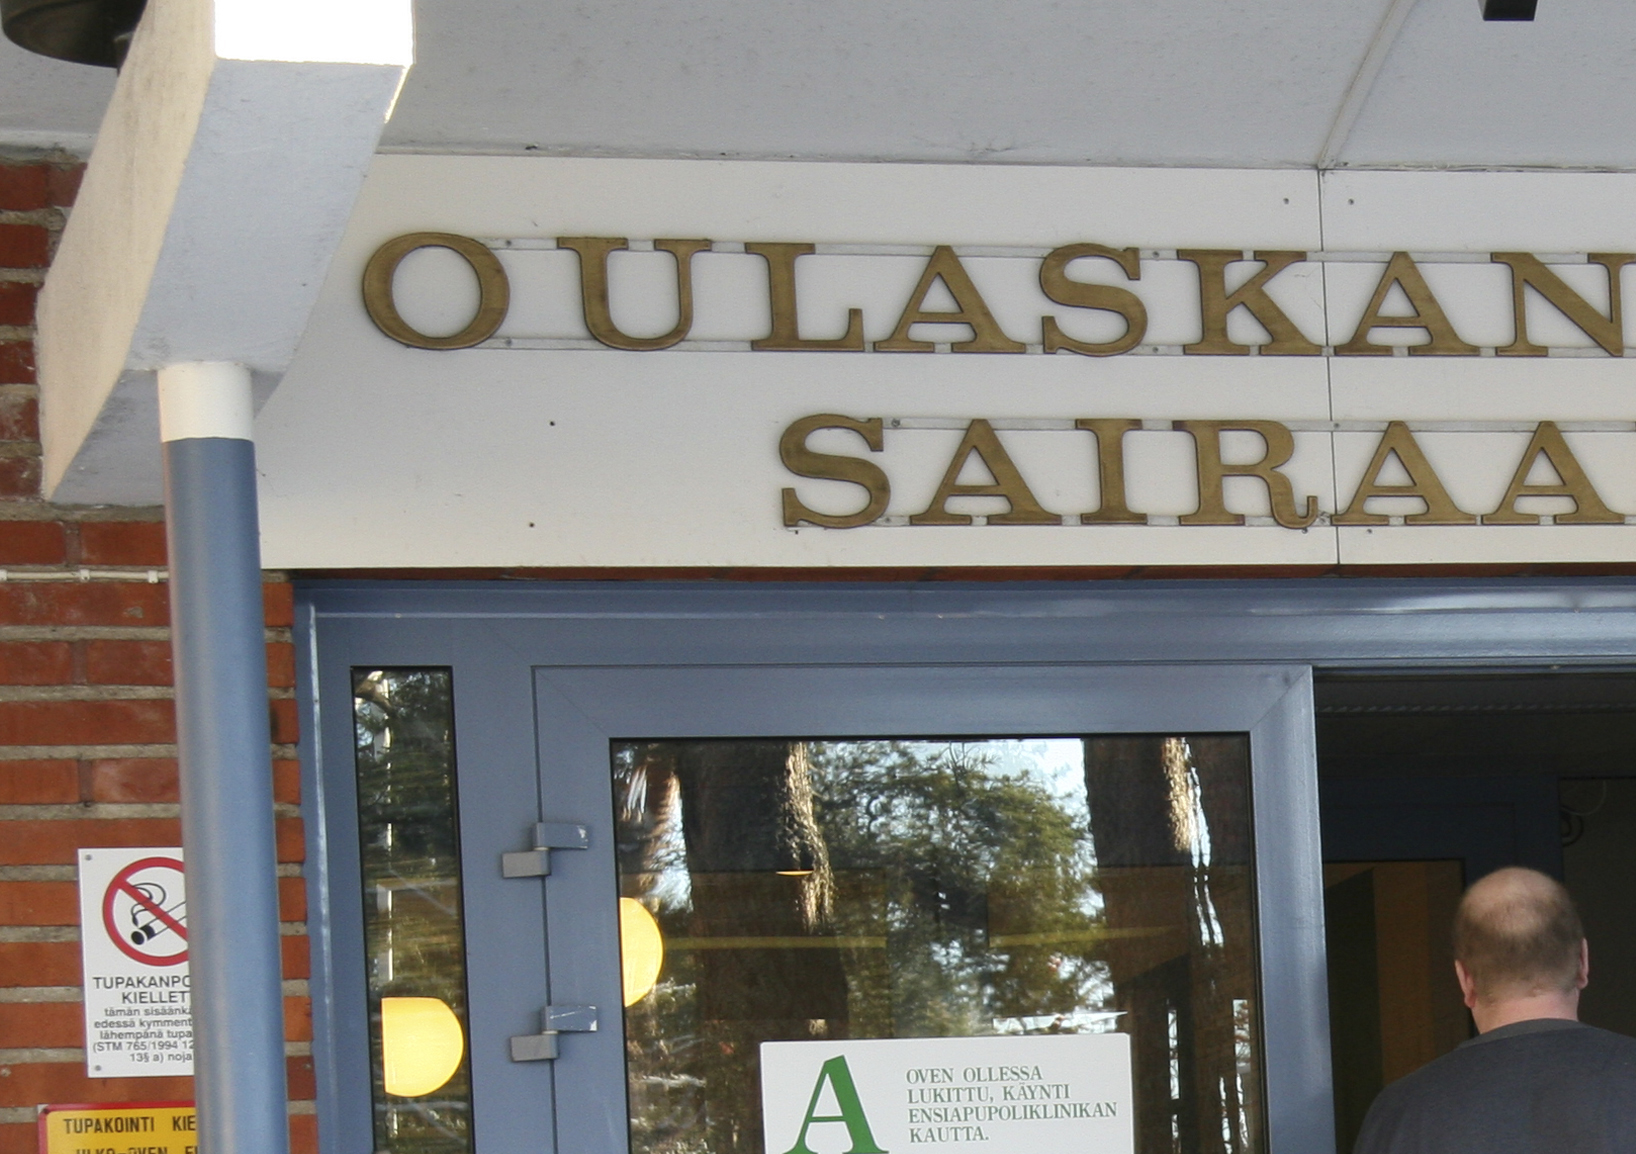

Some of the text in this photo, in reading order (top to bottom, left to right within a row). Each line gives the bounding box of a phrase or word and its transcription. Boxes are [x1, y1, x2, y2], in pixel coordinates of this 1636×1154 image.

[93, 1041, 123, 1053] (STM
[126, 1040, 178, 1051] 765/1994
[906, 1065, 1043, 1085] OVEN OLLESSA
[906, 1081, 1071, 1105] LUKITTU, KÄYNTI
[908, 1102, 1118, 1125] ENSIAPUPOLIKLINIKAN
[63, 1116, 155, 1135] TUPAKOINTI
[909, 1125, 990, 1144] KAUTTA.
